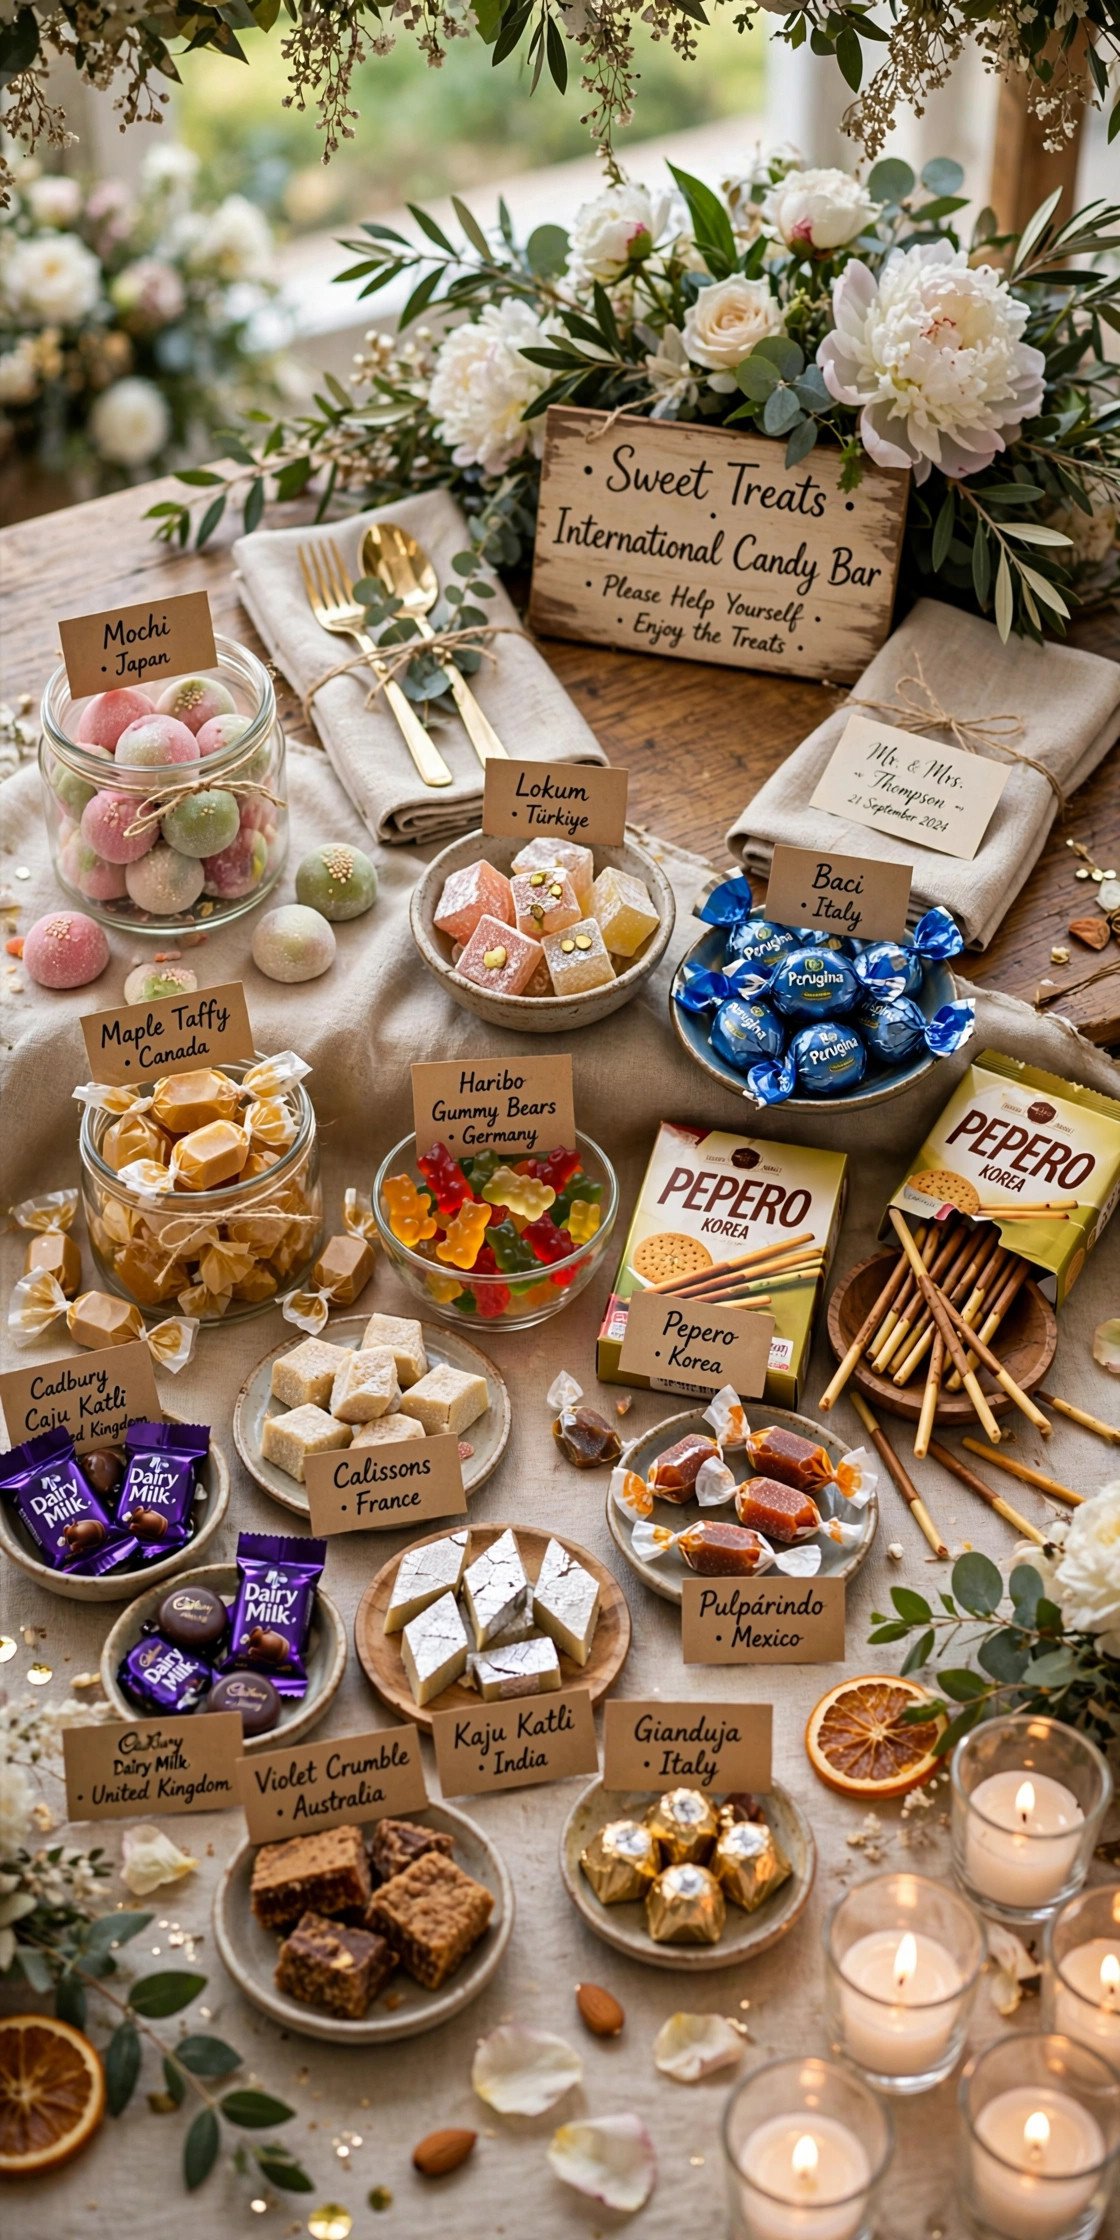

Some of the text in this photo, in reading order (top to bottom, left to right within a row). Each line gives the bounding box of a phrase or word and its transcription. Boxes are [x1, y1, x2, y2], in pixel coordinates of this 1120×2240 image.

[606, 444, 827, 518] Sweet Treats
[552, 507, 882, 596] International Candy Bar
[602, 574, 804, 633] Please Help Yourself
[103, 613, 171, 649] Mochi
[633, 613, 786, 654] Enjoy the Treats
[115, 651, 171, 678] Japan
[866, 742, 963, 789] Mr. & Mrs.
[515, 772, 589, 801] Lokum
[867, 770, 945, 808] Thompson
[526, 804, 589, 836] Türkiye
[863, 797, 917, 822] September
[918, 815, 949, 832] 2024
[811, 863, 865, 895] Baci
[812, 896, 864, 933] Italy
[788, 970, 844, 988] Perugina
[101, 998, 231, 1050] Maple Taffy
[138, 1035, 210, 1068] Canada
[459, 1069, 526, 1094] Haribo
[431, 1096, 557, 1128] Gummy Bears
[462, 1125, 539, 1150] Germany
[945, 1109, 1096, 1190] PEPERO
[978, 1163, 1026, 1193] KOREA
[657, 1167, 813, 1228] PEPERO
[701, 1217, 750, 1240] KOREA
[662, 1310, 739, 1348] Pepero
[668, 1346, 723, 1374] Korea
[30, 1369, 109, 1400] Cadbury
[25, 1386, 126, 1431] Caju Katli
[129, 1468, 179, 1490] Dairy
[333, 1457, 431, 1489] Calissons
[30, 1479, 78, 1515] Dairy
[356, 1490, 422, 1515] France
[244, 1583, 298, 1608] Dairy
[700, 1589, 827, 1625] Pulpárindo
[731, 1626, 804, 1648] Mexico
[143, 1648, 184, 1684] Dairy
[454, 1704, 576, 1755] Kaju Katli
[634, 1714, 742, 1753] Gianduja
[113, 1753, 190, 1777] Dairy Milk
[254, 1743, 411, 1794] Violet Crumble
[493, 1746, 548, 1775] India
[658, 1751, 719, 1786] Italy
[92, 1773, 233, 1805] United Kingdom
[292, 1784, 385, 1821] Australia
